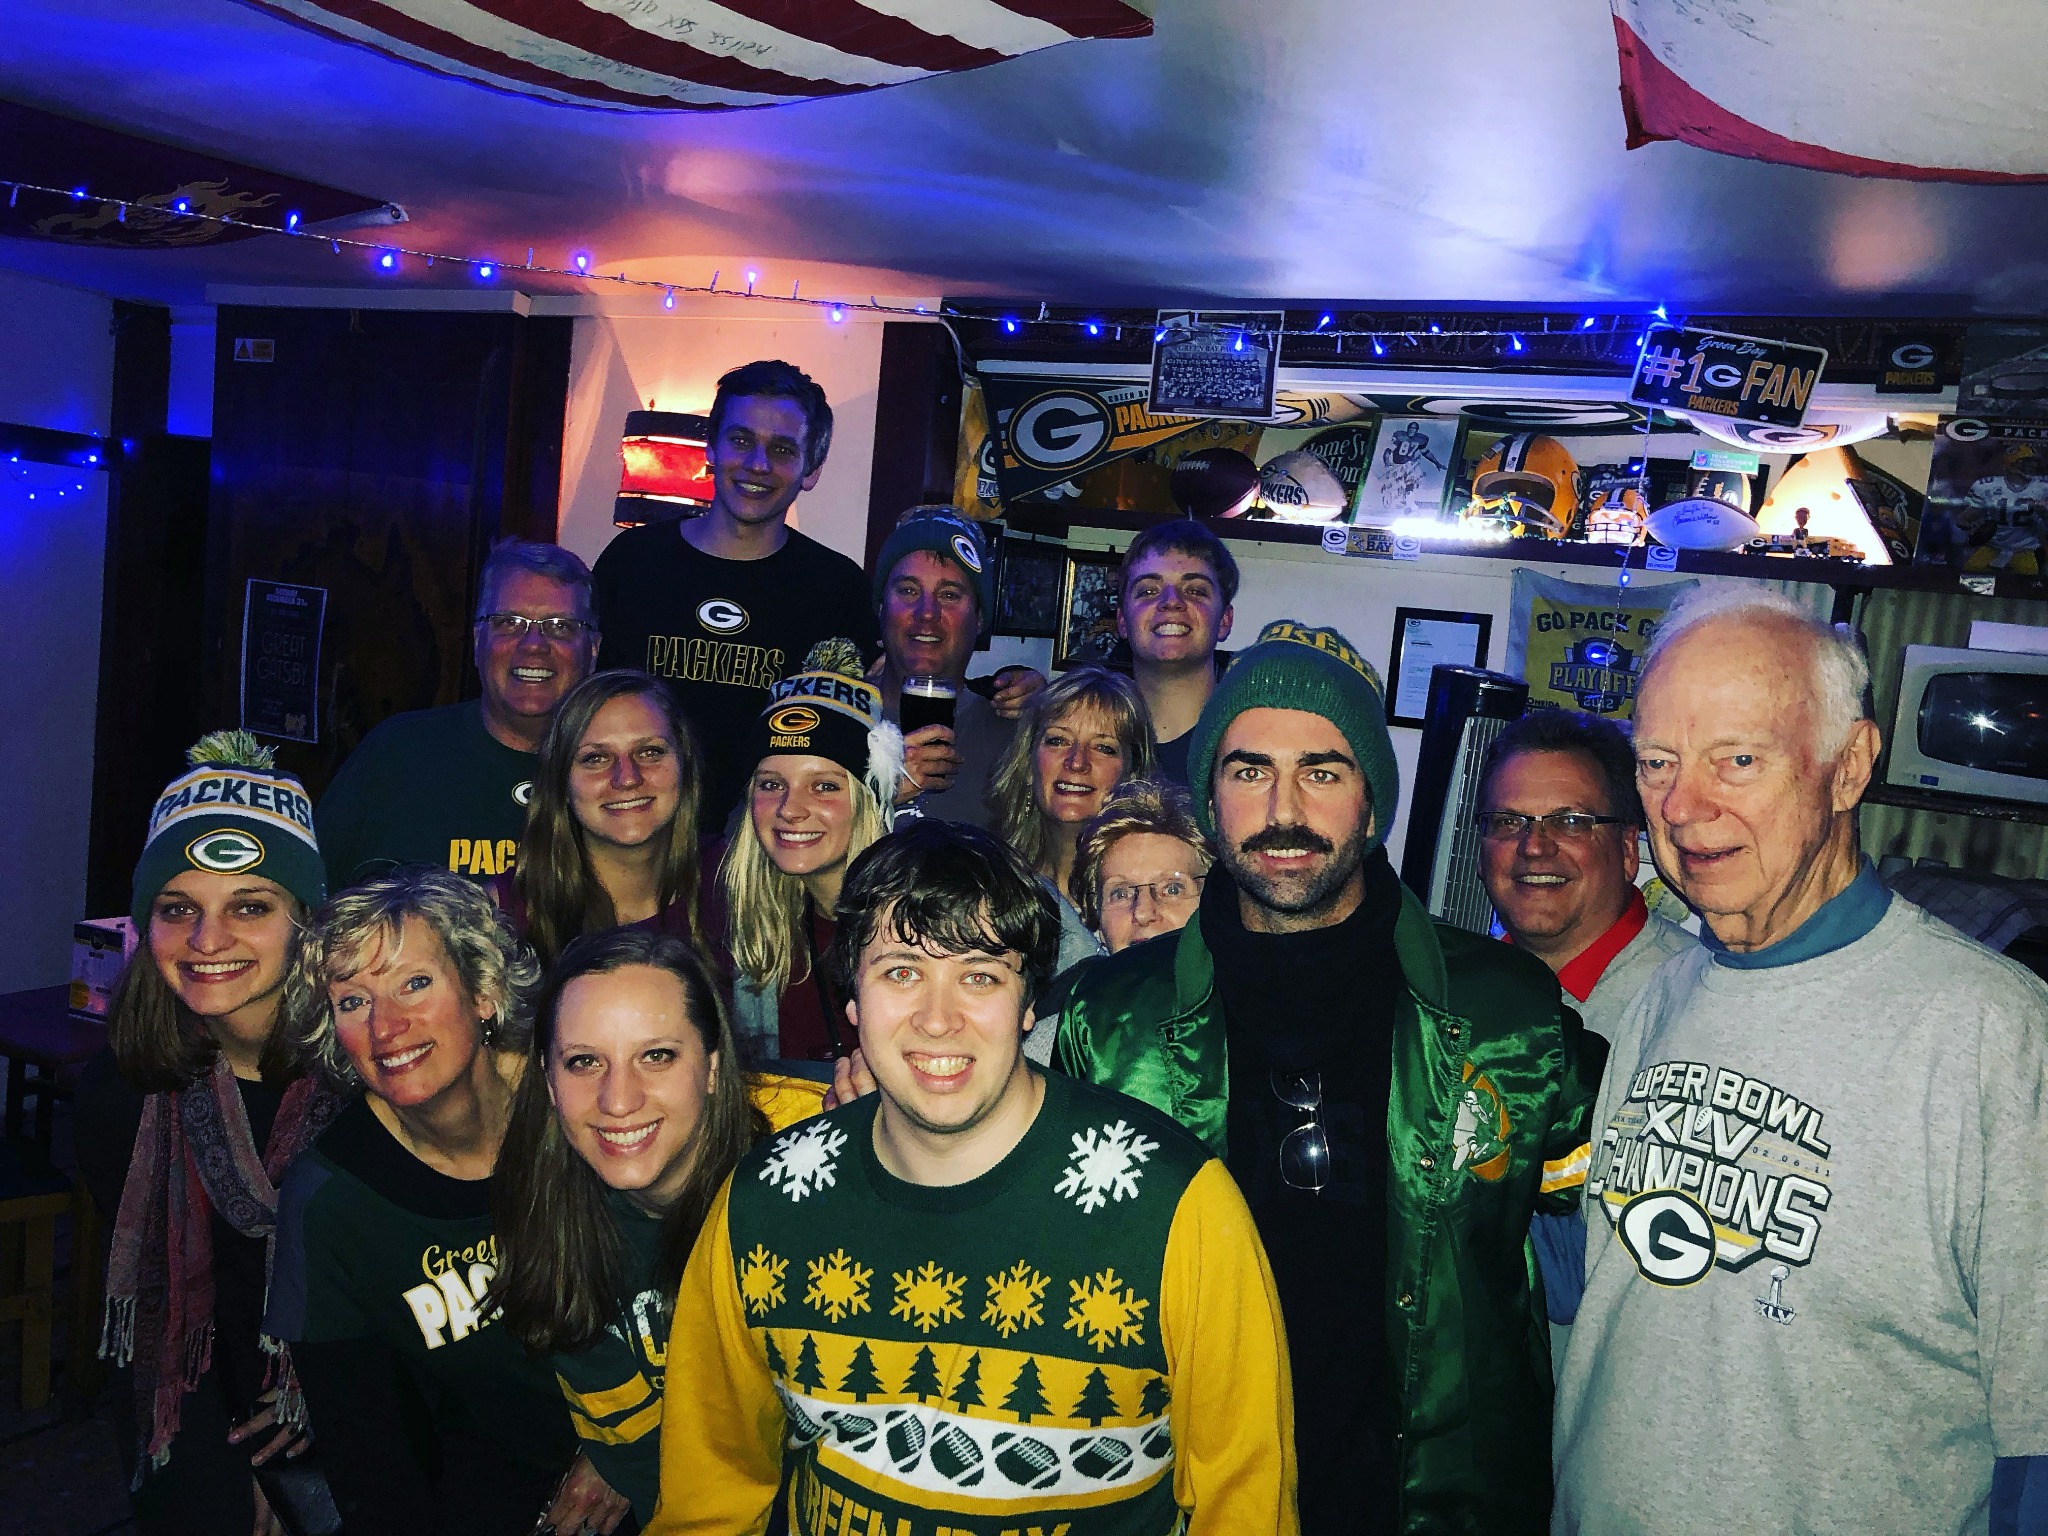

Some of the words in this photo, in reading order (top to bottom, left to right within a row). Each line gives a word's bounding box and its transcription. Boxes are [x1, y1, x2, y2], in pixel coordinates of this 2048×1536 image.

[1695, 336, 1735, 351] Green
[1736, 342, 1768, 359] Bay
[1643, 345, 1705, 394] #1
[1741, 360, 1815, 410] FAN
[1885, 371, 1936, 385] PACKERS
[1108, 390, 1135, 403] GREEN
[1138, 389, 1149, 399] BA
[1687, 394, 1740, 416] PACKERS
[1399, 443, 1419, 457] 87
[1998, 498, 2034, 527] 12
[1366, 541, 1394, 552] BAY
[1536, 611, 1566, 633] GO
[1569, 611, 1632, 633] PACK
[646, 635, 785, 690] PACKERS
[773, 676, 872, 716] CKERS
[1526, 697, 1560, 708] ONEIDA
[1583, 697, 1614, 709] 2012
[769, 735, 811, 748] PACKERS
[153, 778, 312, 830] PACKERS
[448, 838, 518, 875] PAC
[1630, 1061, 1710, 1106] UPER
[1710, 1067, 1832, 1161] BOWL
[1636, 1099, 1765, 1164] XLV
[1588, 1126, 1833, 1268] CHAMPIONS
[401, 1262, 505, 1350] PAC
